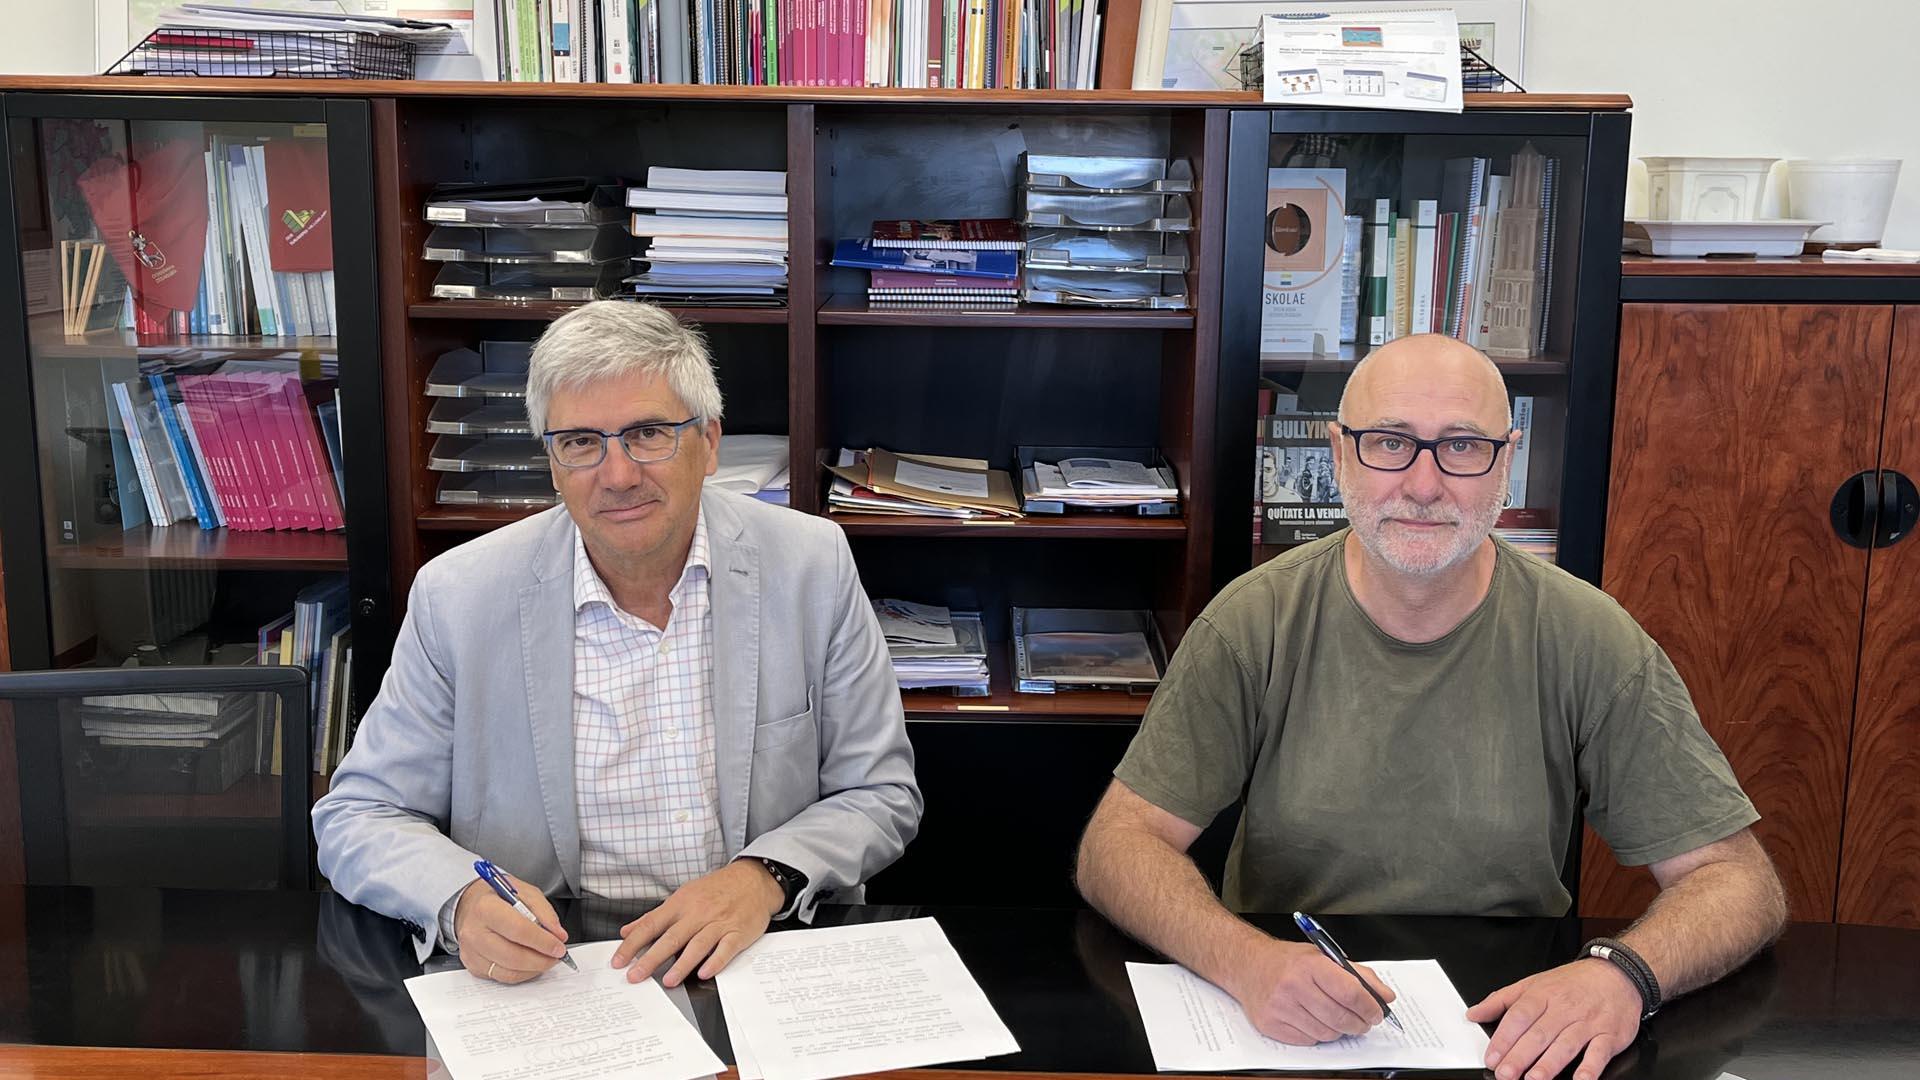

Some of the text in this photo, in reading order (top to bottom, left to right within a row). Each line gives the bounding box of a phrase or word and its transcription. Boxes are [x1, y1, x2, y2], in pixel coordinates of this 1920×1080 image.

[1265, 292, 1306, 305] SKOLAE
[1272, 419, 1330, 439] BULLYIN
[1267, 505, 1303, 520] QUÍTATE
[1304, 507, 1315, 519] LA
[1316, 507, 1348, 519] VENDA
